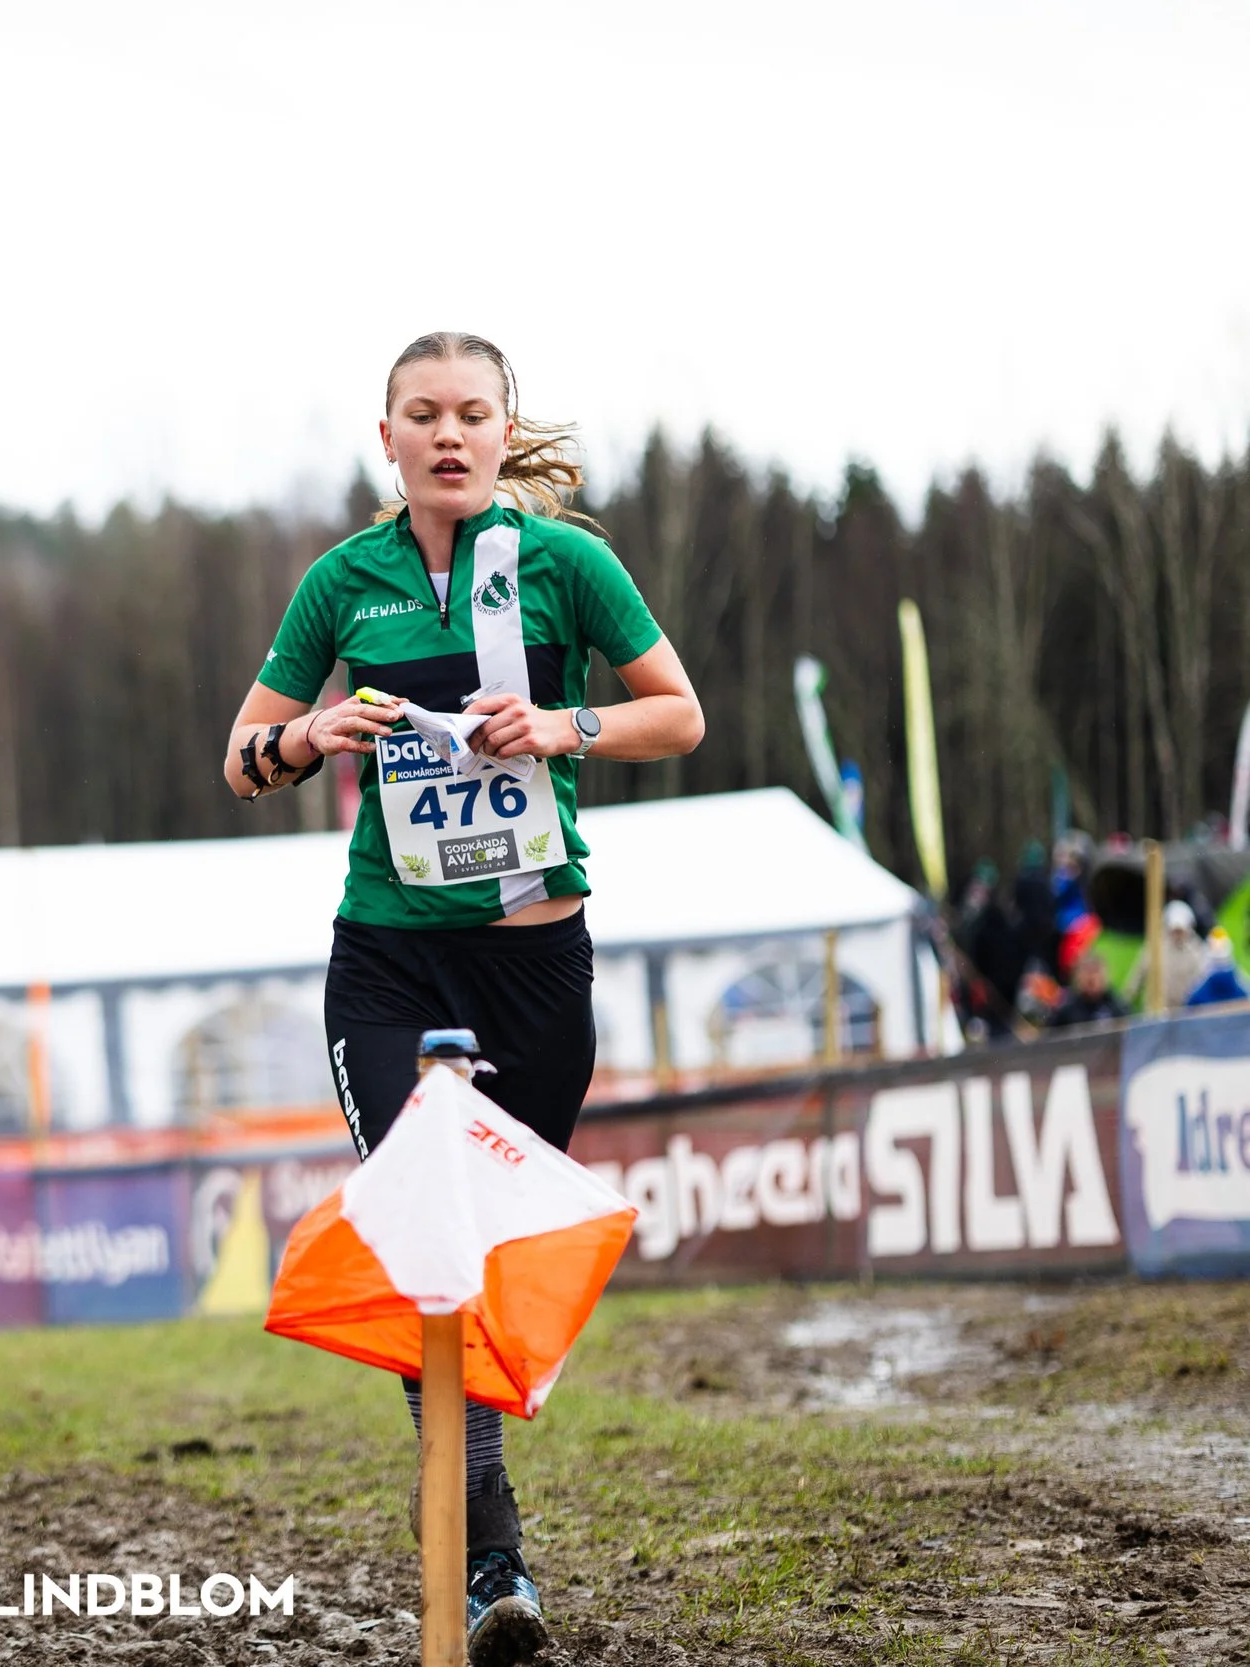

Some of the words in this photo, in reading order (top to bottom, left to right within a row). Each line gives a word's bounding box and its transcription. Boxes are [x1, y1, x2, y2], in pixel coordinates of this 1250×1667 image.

[353, 599, 424, 622] ALEWALDS
[397, 765, 458, 780] KOLMÅRDSME
[409, 773, 527, 830] 476
[445, 837, 508, 854] GODKÄNDA
[447, 846, 508, 867] AVLOPP
[866, 1064, 1121, 1258] SILVA
